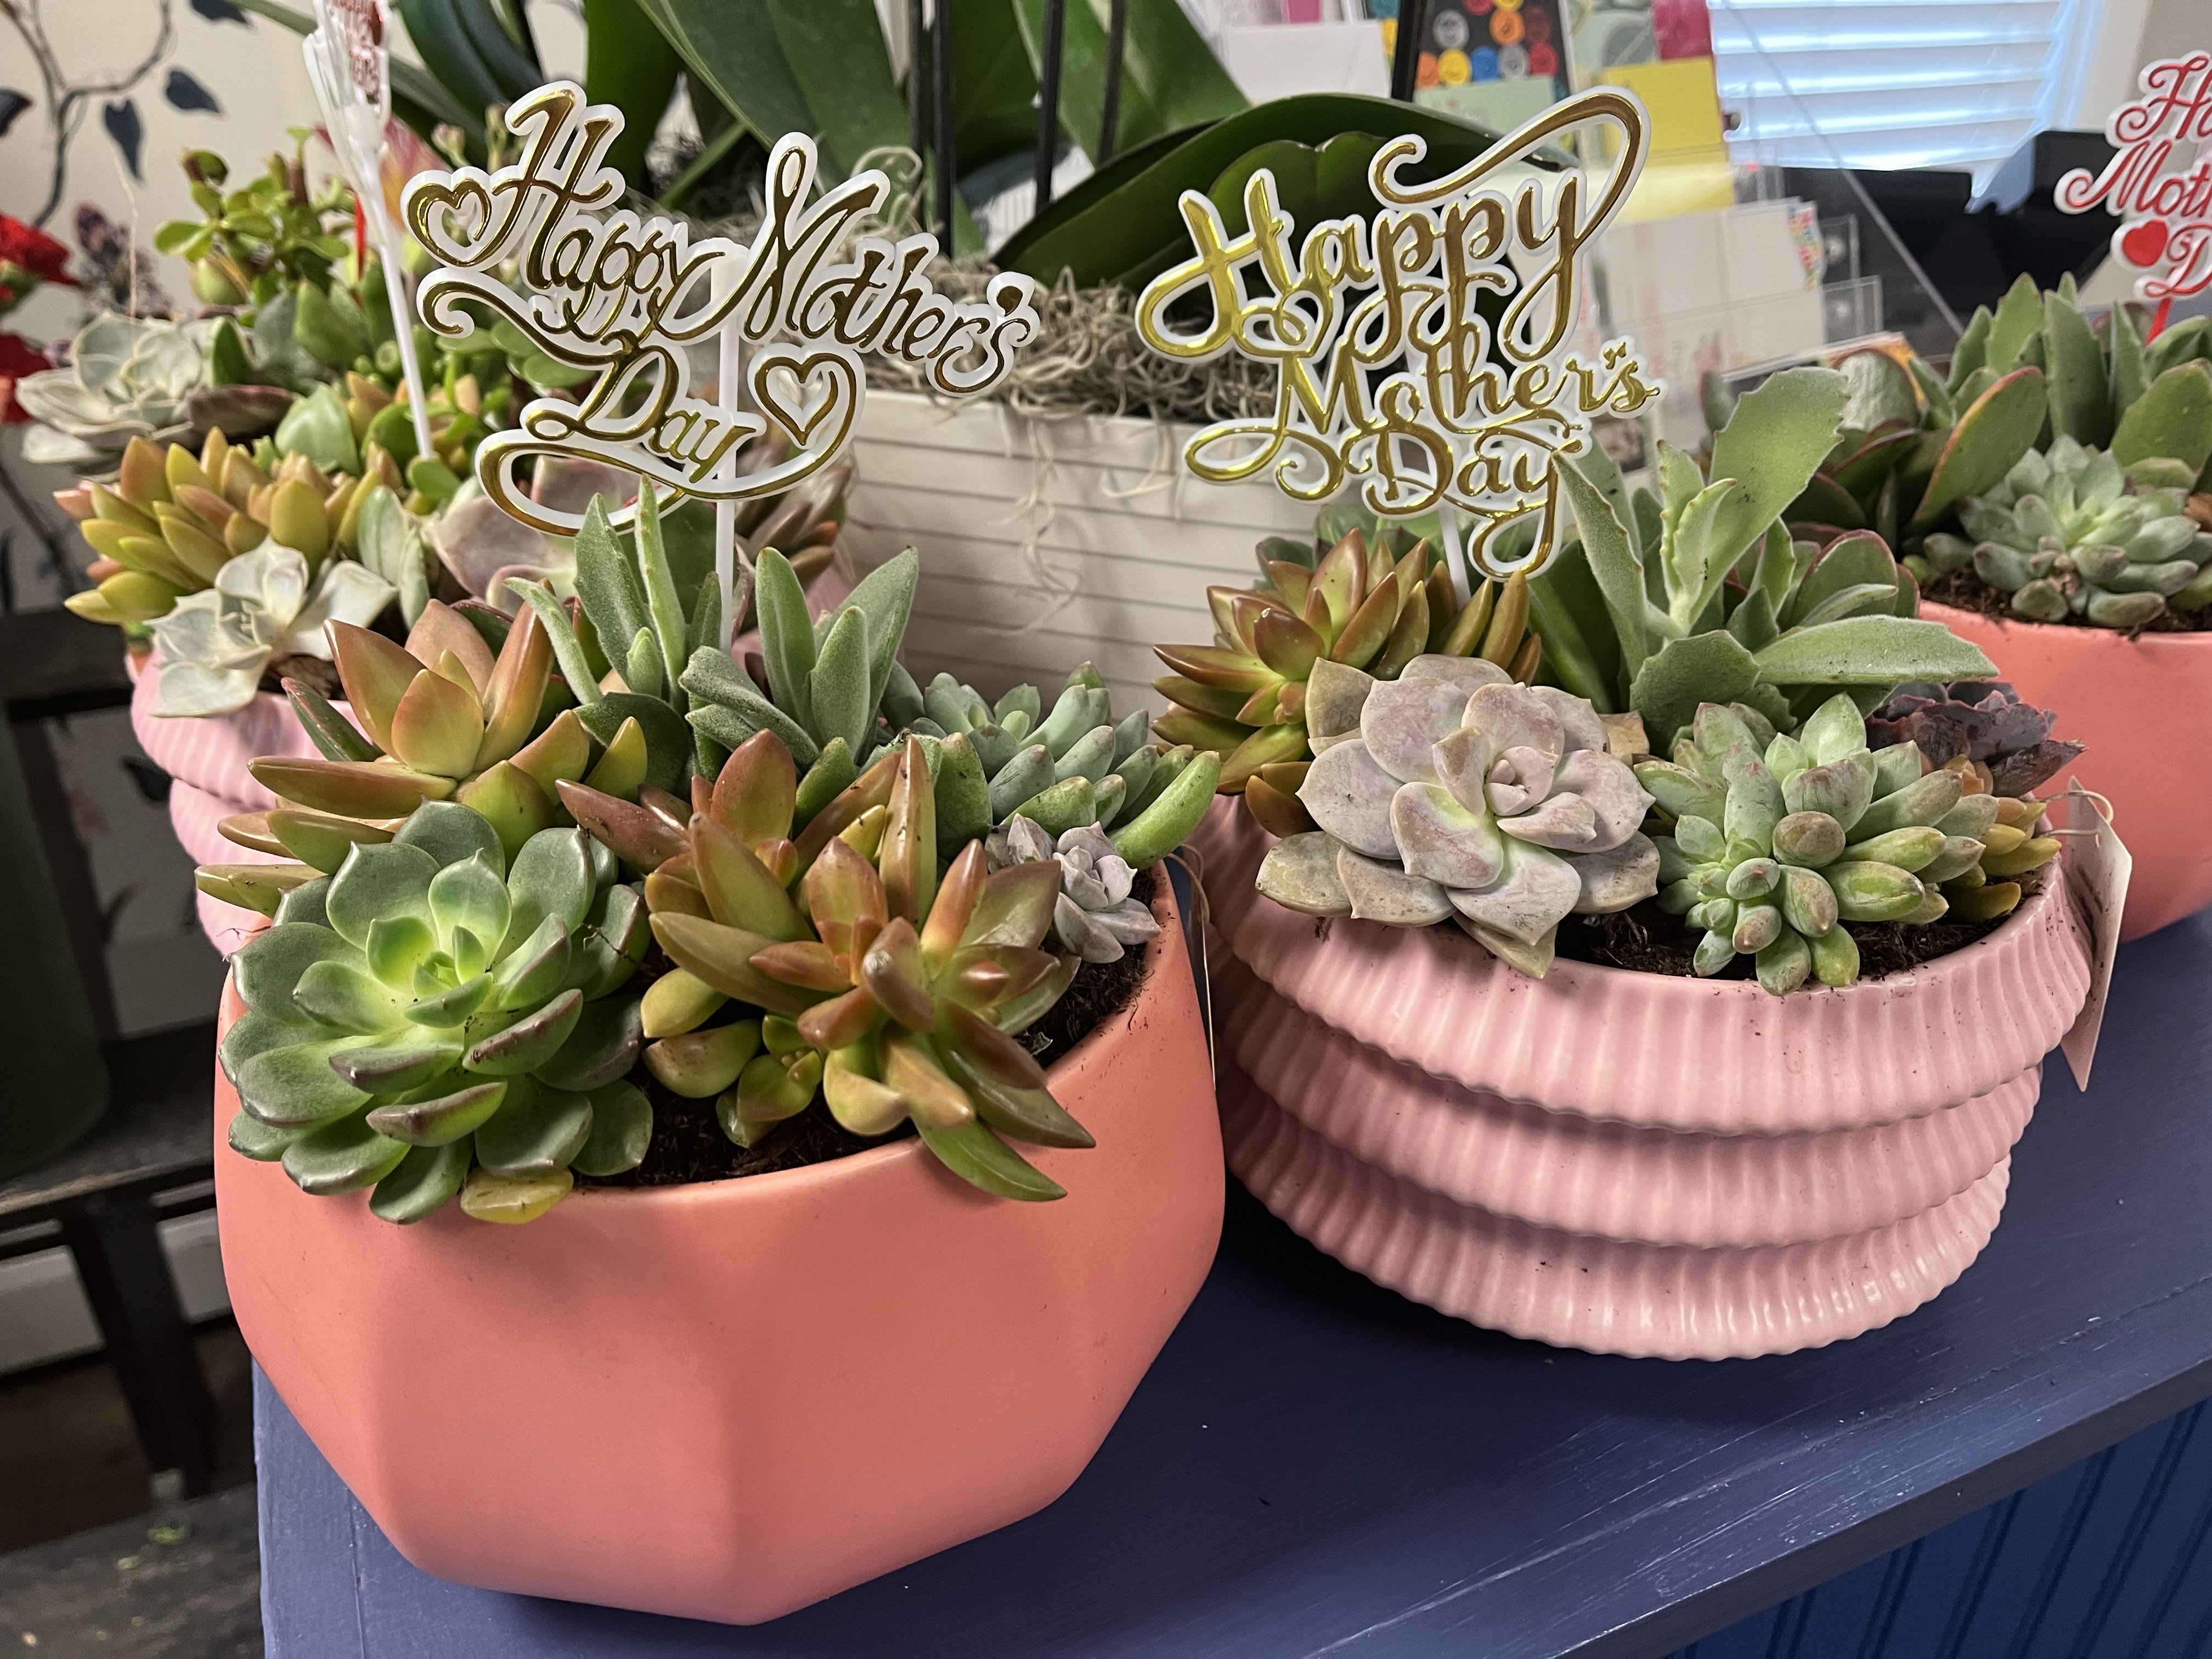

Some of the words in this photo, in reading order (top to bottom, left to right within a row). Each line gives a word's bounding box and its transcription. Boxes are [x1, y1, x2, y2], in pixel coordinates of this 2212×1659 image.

[483, 88, 692, 341] Happy
[658, 146, 1030, 393] Mother's
[1139, 92, 1642, 363] Happy
[524, 331, 760, 484] Day
[1185, 323, 1660, 483] Mother's
[1343, 421, 1583, 576] Day
